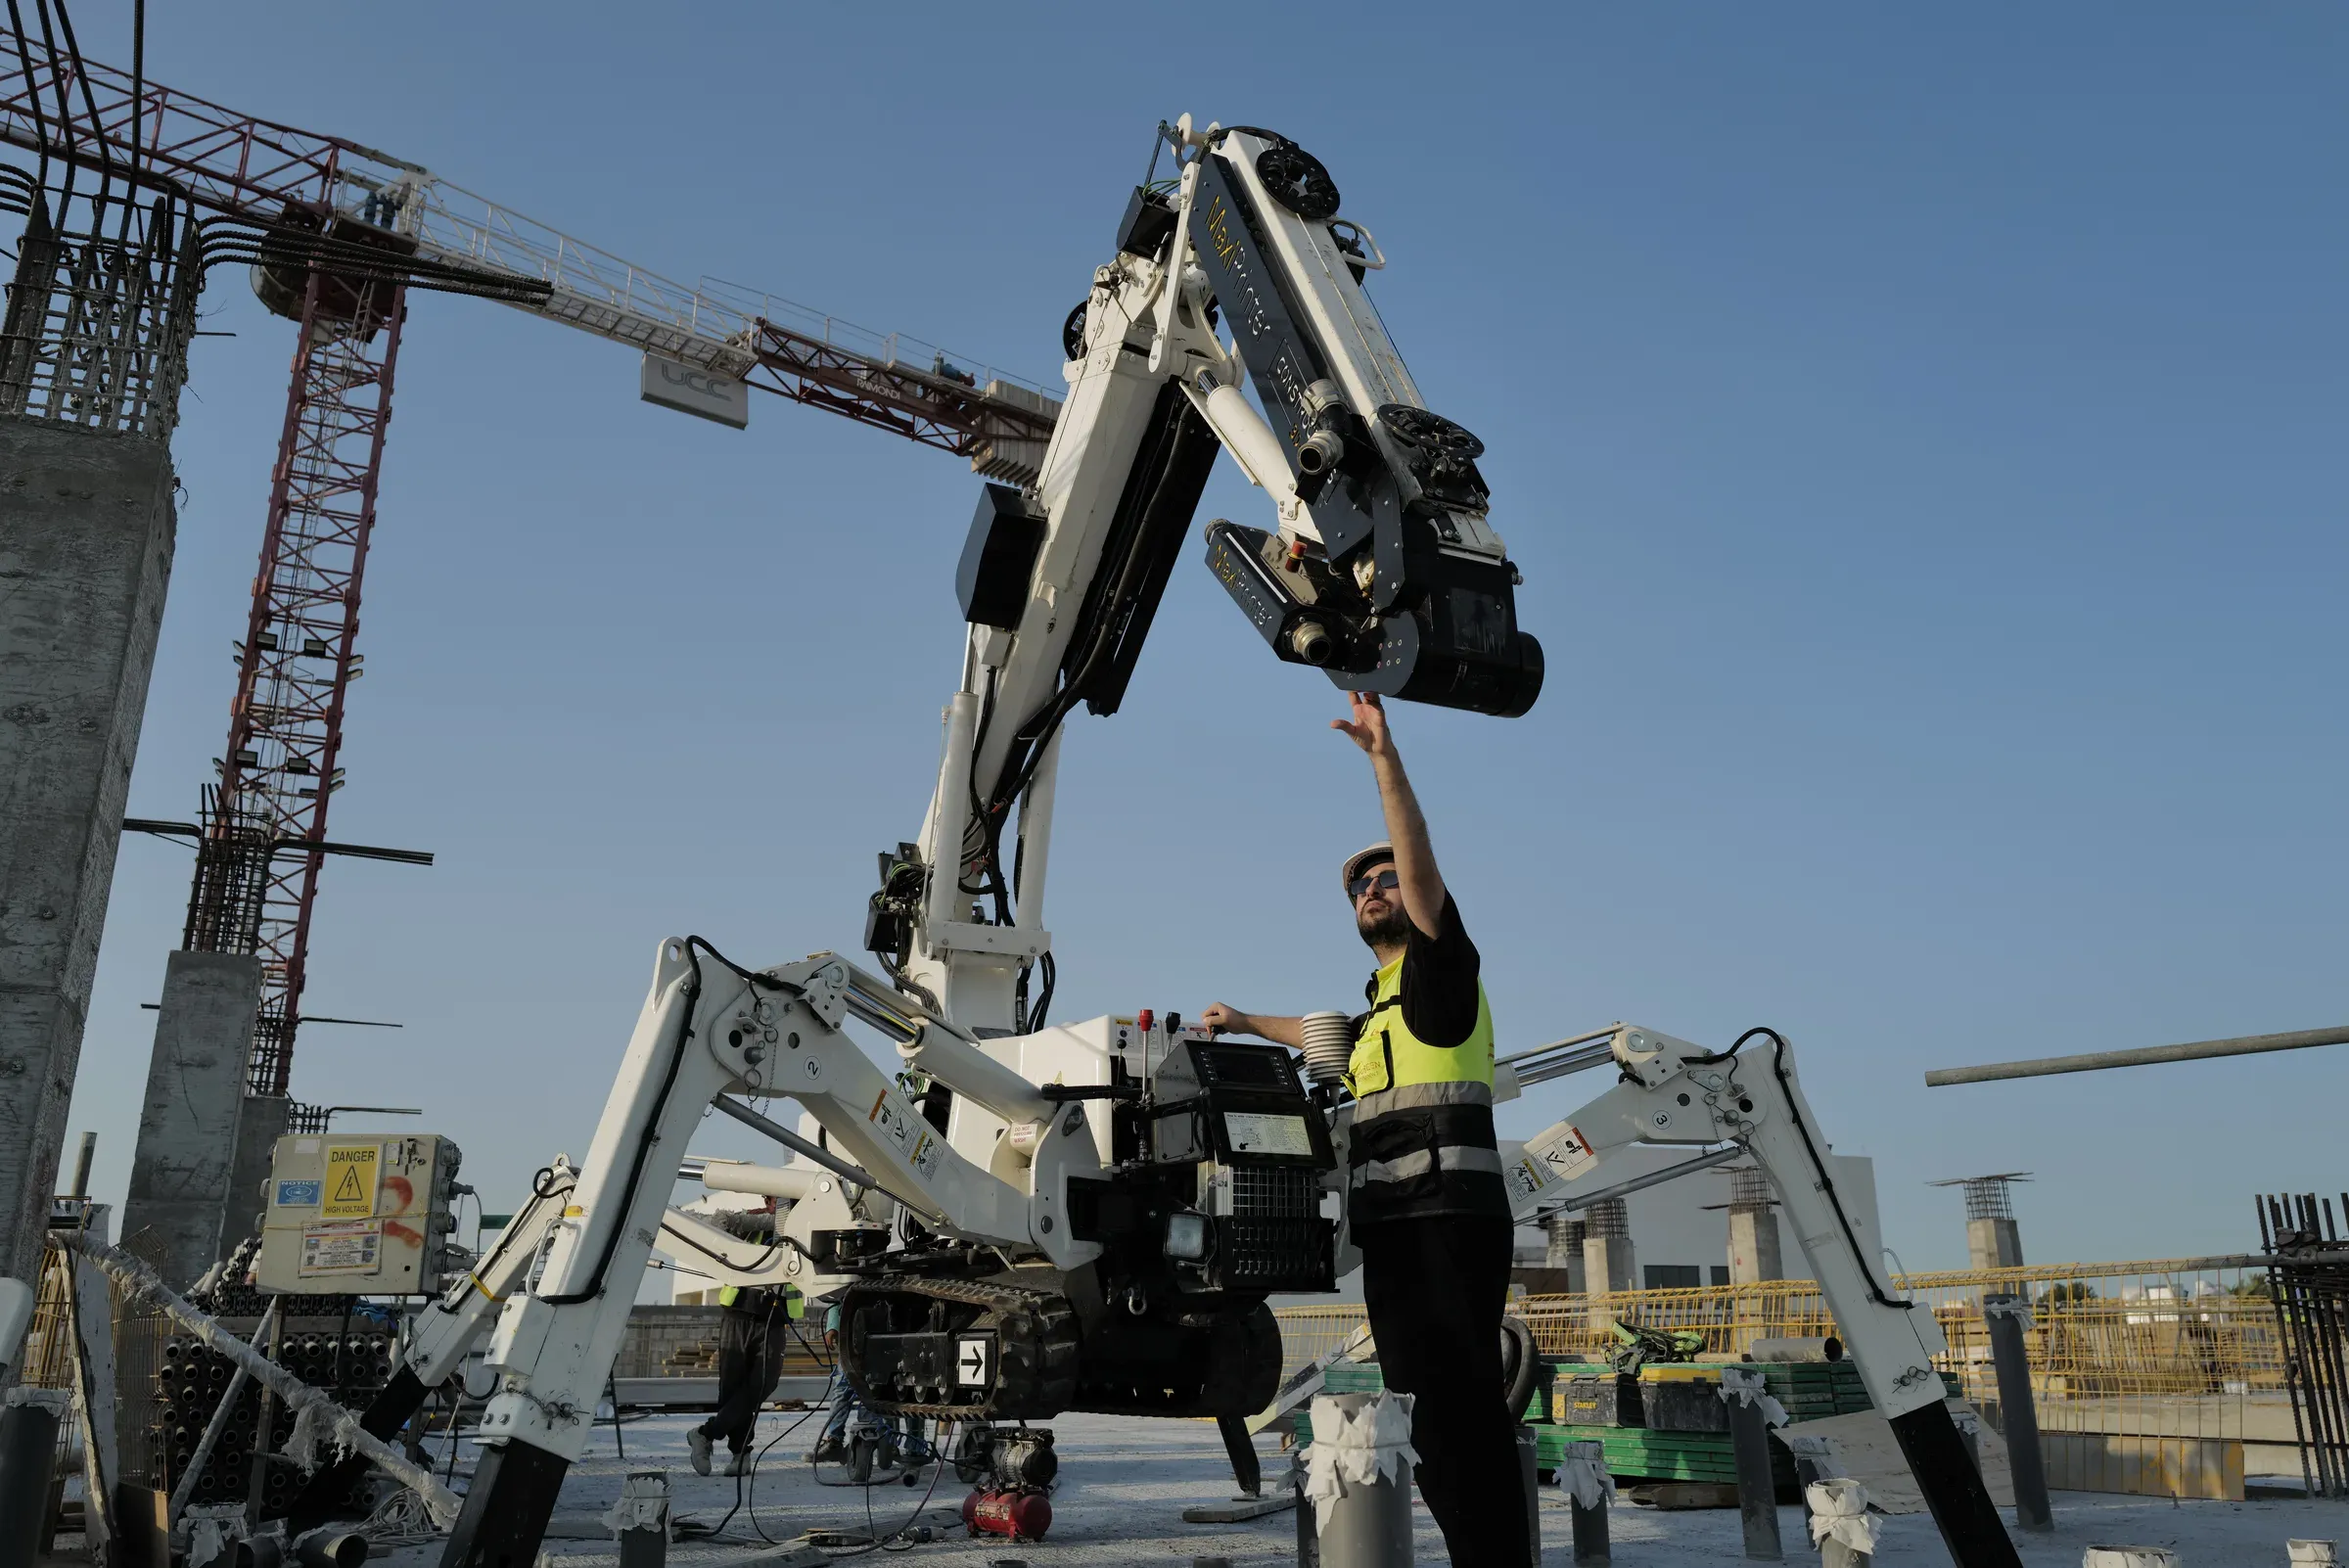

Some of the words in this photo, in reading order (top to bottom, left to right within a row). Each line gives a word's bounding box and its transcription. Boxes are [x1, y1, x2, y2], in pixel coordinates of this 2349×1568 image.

[1204, 195, 1272, 342] MaxiPrinter
[662, 363, 732, 402] UCC
[856, 378, 900, 400] RAIMONDI
[1212, 544, 1272, 628] MaxiPrinter
[807, 1061, 818, 1075] 2
[1656, 1114, 1668, 1125] 3
[331, 1150, 375, 1163] DANGER
[342, 1205, 369, 1214] VOLTAGE
